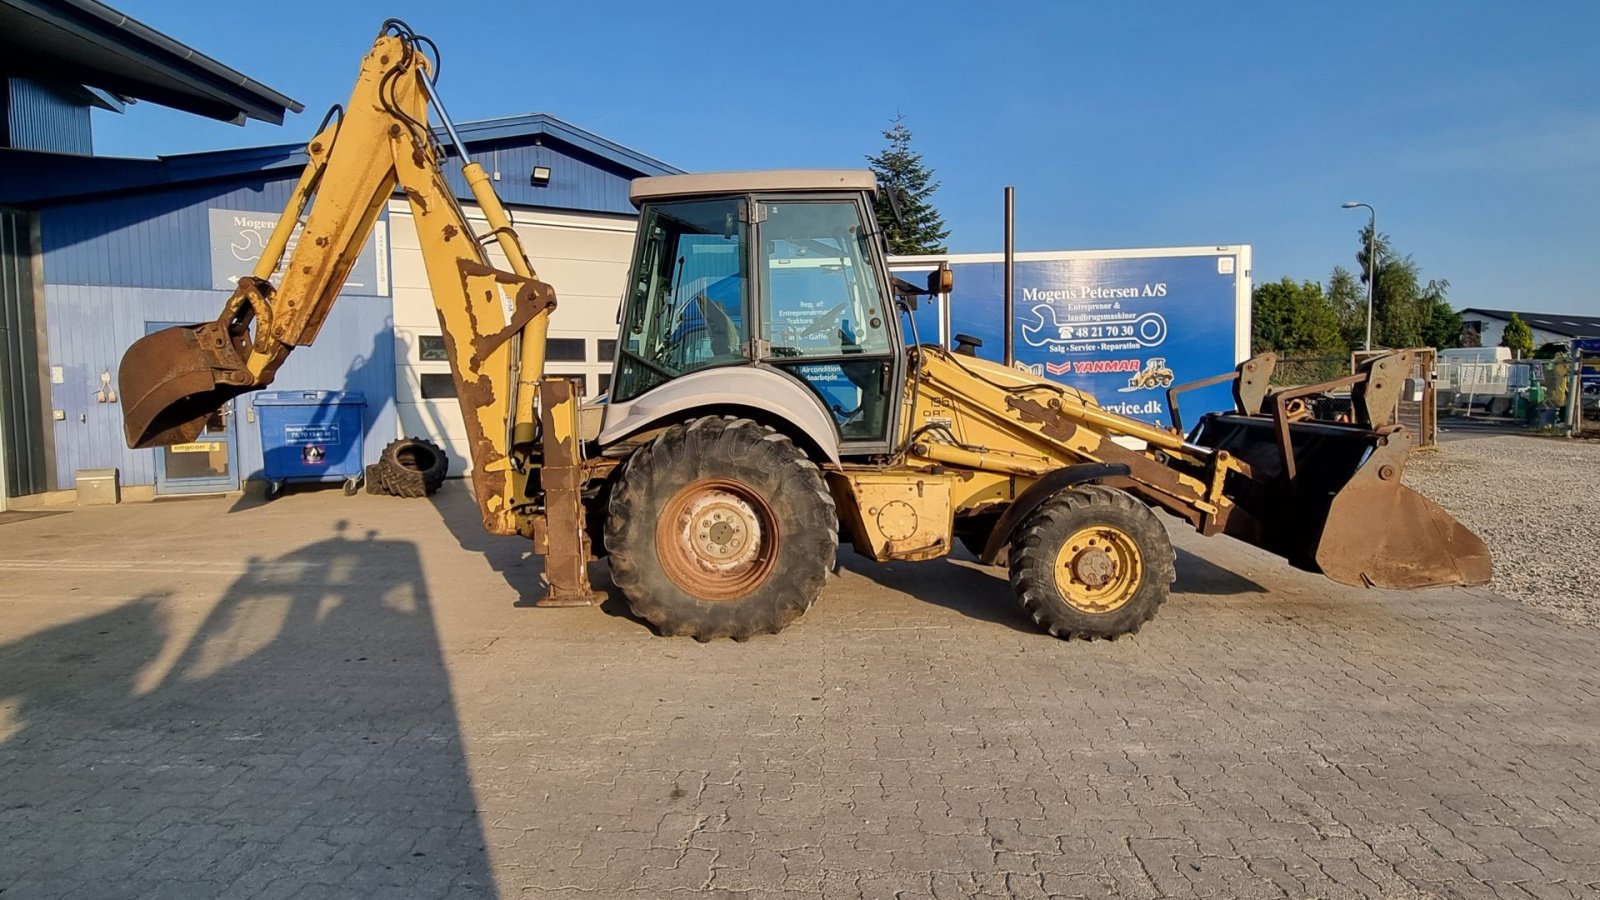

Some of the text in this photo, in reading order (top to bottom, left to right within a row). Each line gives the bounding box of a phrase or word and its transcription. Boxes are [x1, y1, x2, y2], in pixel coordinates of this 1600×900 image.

[1022, 283, 1167, 303] Mogens Petersen A/S
[1113, 302, 1121, 310] &
[1067, 312, 1137, 322] landbrugsmaskiner
[1075, 325, 1134, 338] 48 21 70 30
[1049, 341, 1141, 354] Salg Service Reparation
[801, 364, 841, 373] Aircondition
[1073, 360, 1140, 373] YANMAR
